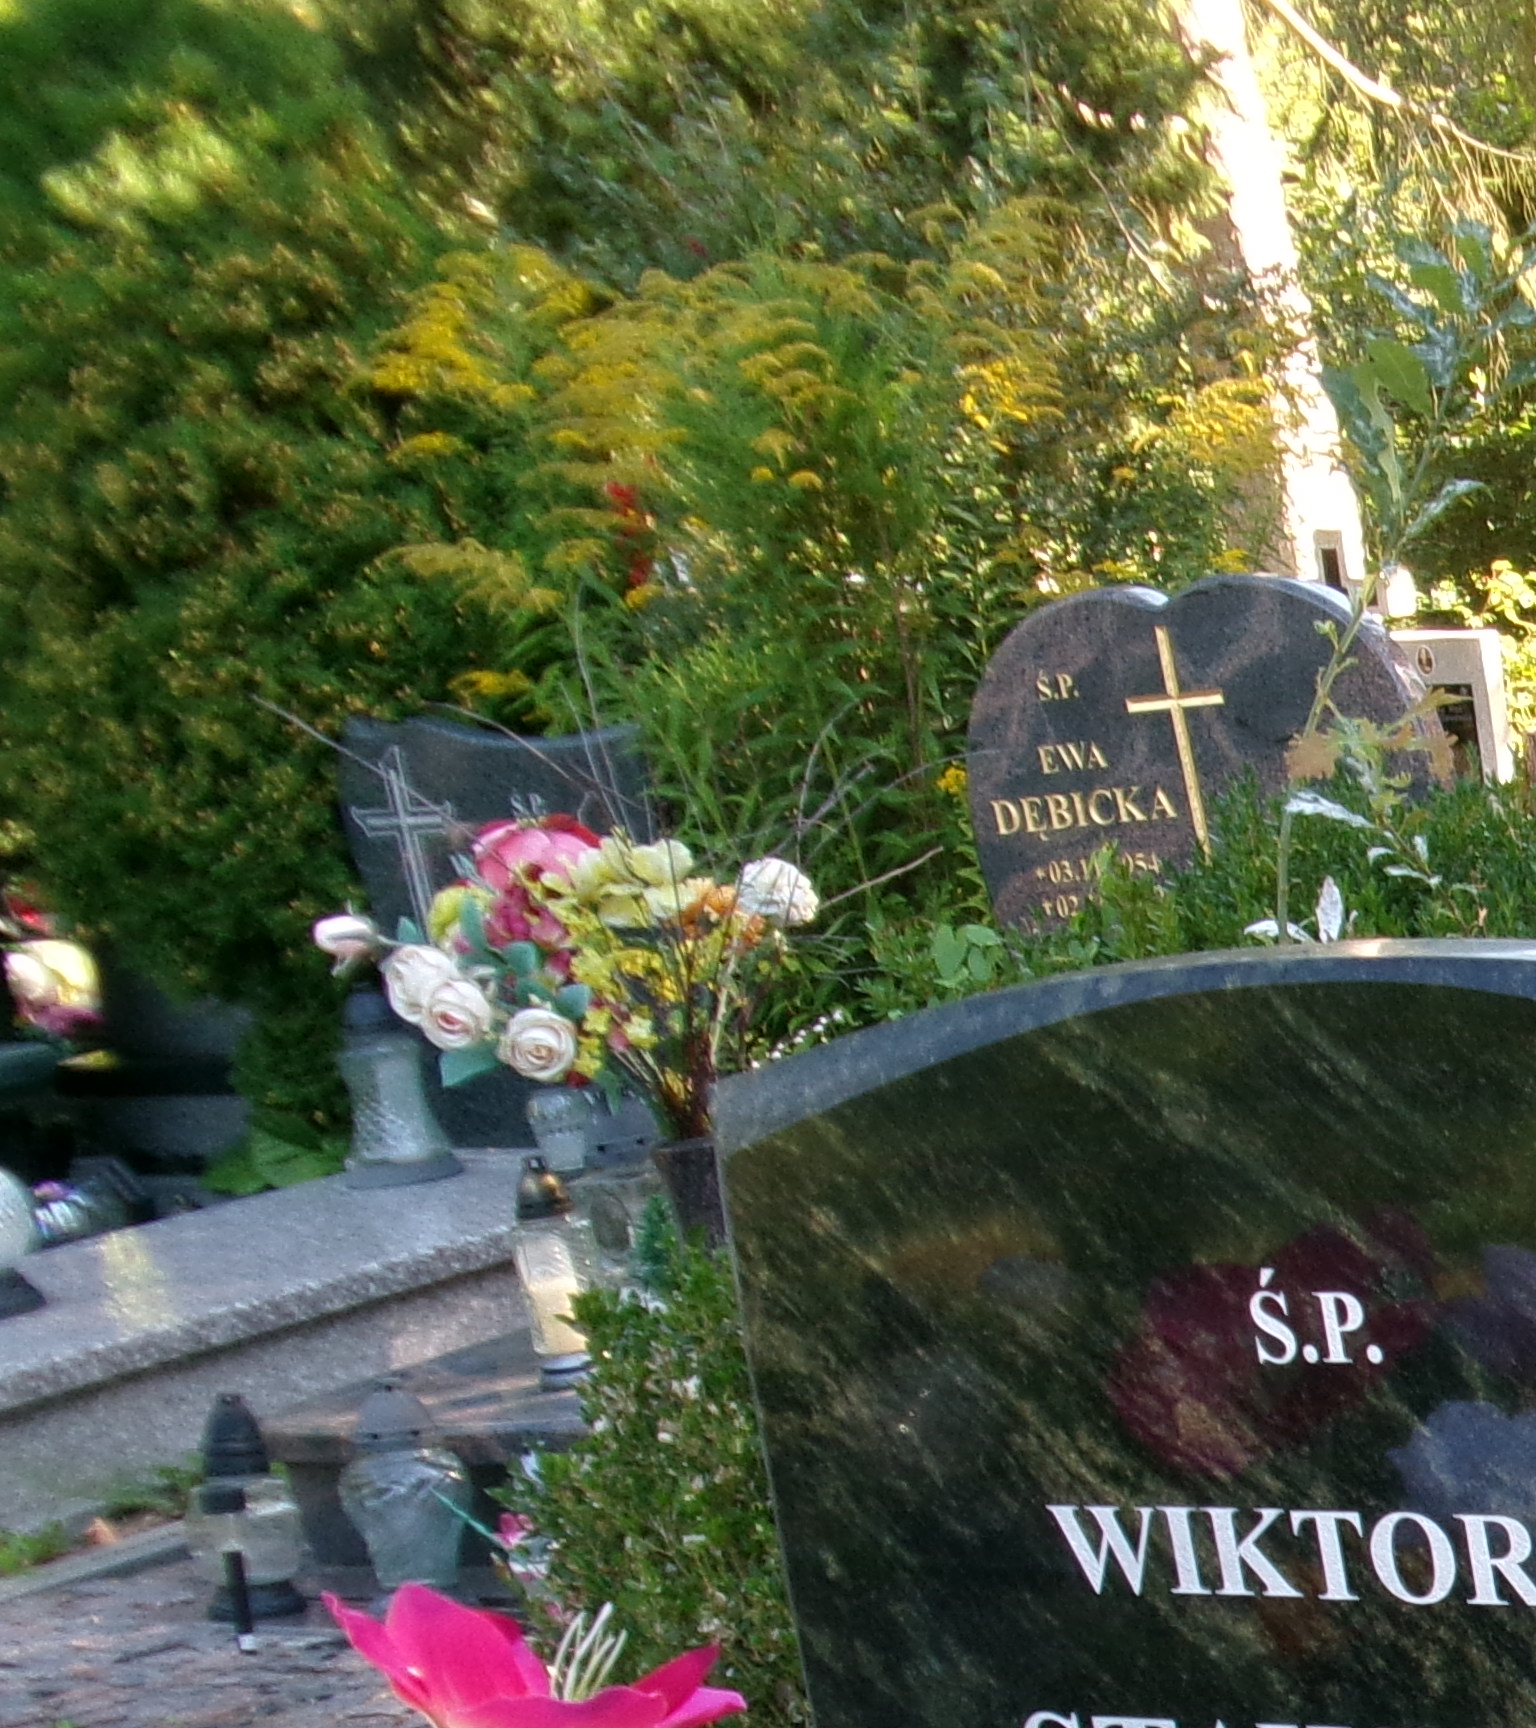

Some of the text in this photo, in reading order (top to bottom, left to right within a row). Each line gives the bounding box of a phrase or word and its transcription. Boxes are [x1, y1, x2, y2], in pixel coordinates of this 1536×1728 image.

[1038, 740, 1108, 775] EWA
[990, 784, 1178, 842] DĘBICKA
[1248, 1267, 1384, 1366] Ś.P.
